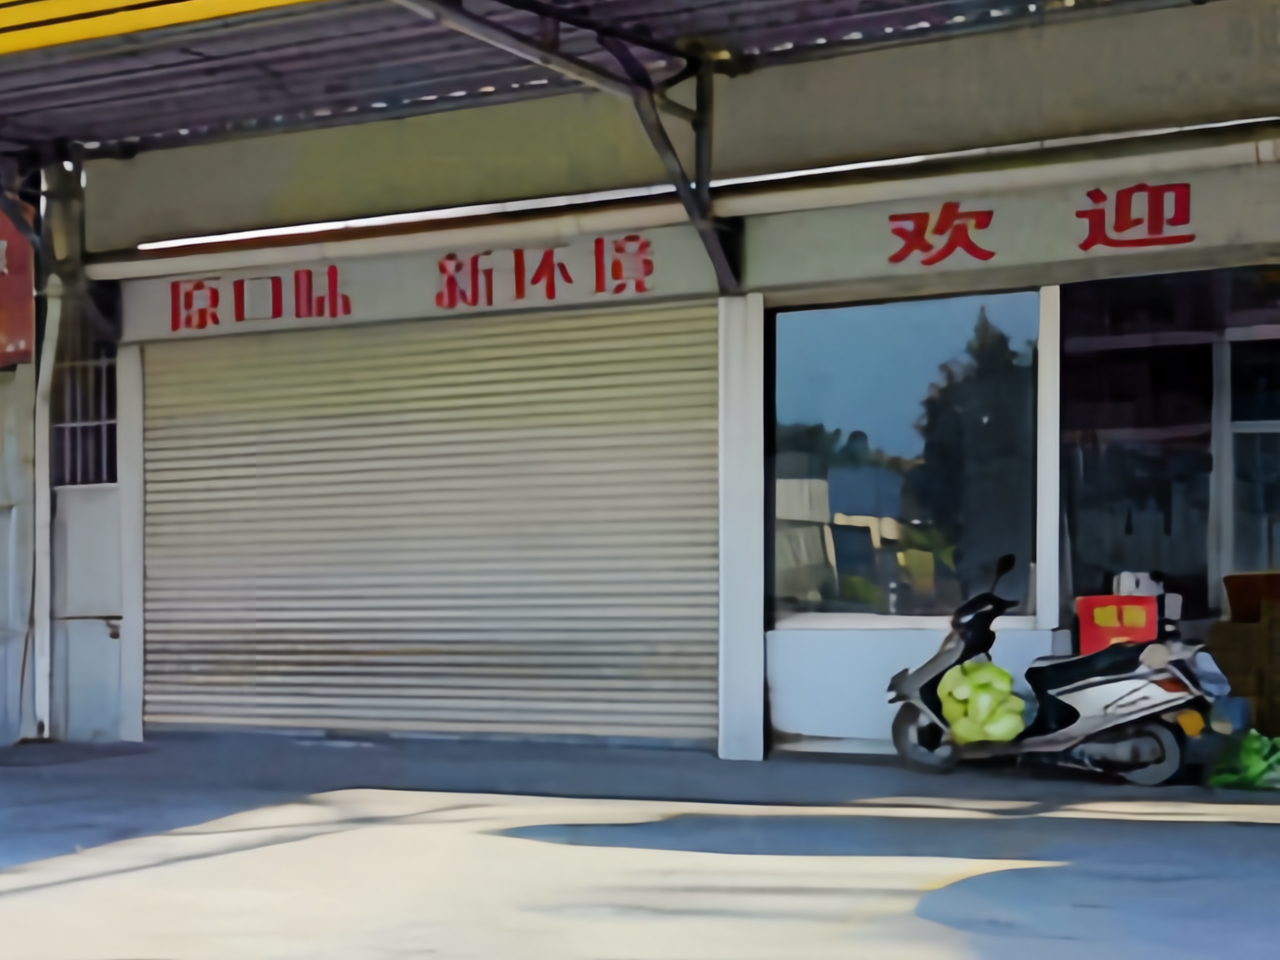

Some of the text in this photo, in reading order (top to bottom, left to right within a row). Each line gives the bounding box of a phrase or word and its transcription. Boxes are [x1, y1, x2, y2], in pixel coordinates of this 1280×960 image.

[888, 183, 1196, 266] 欢迎
[170, 261, 352, 332] 原口味
